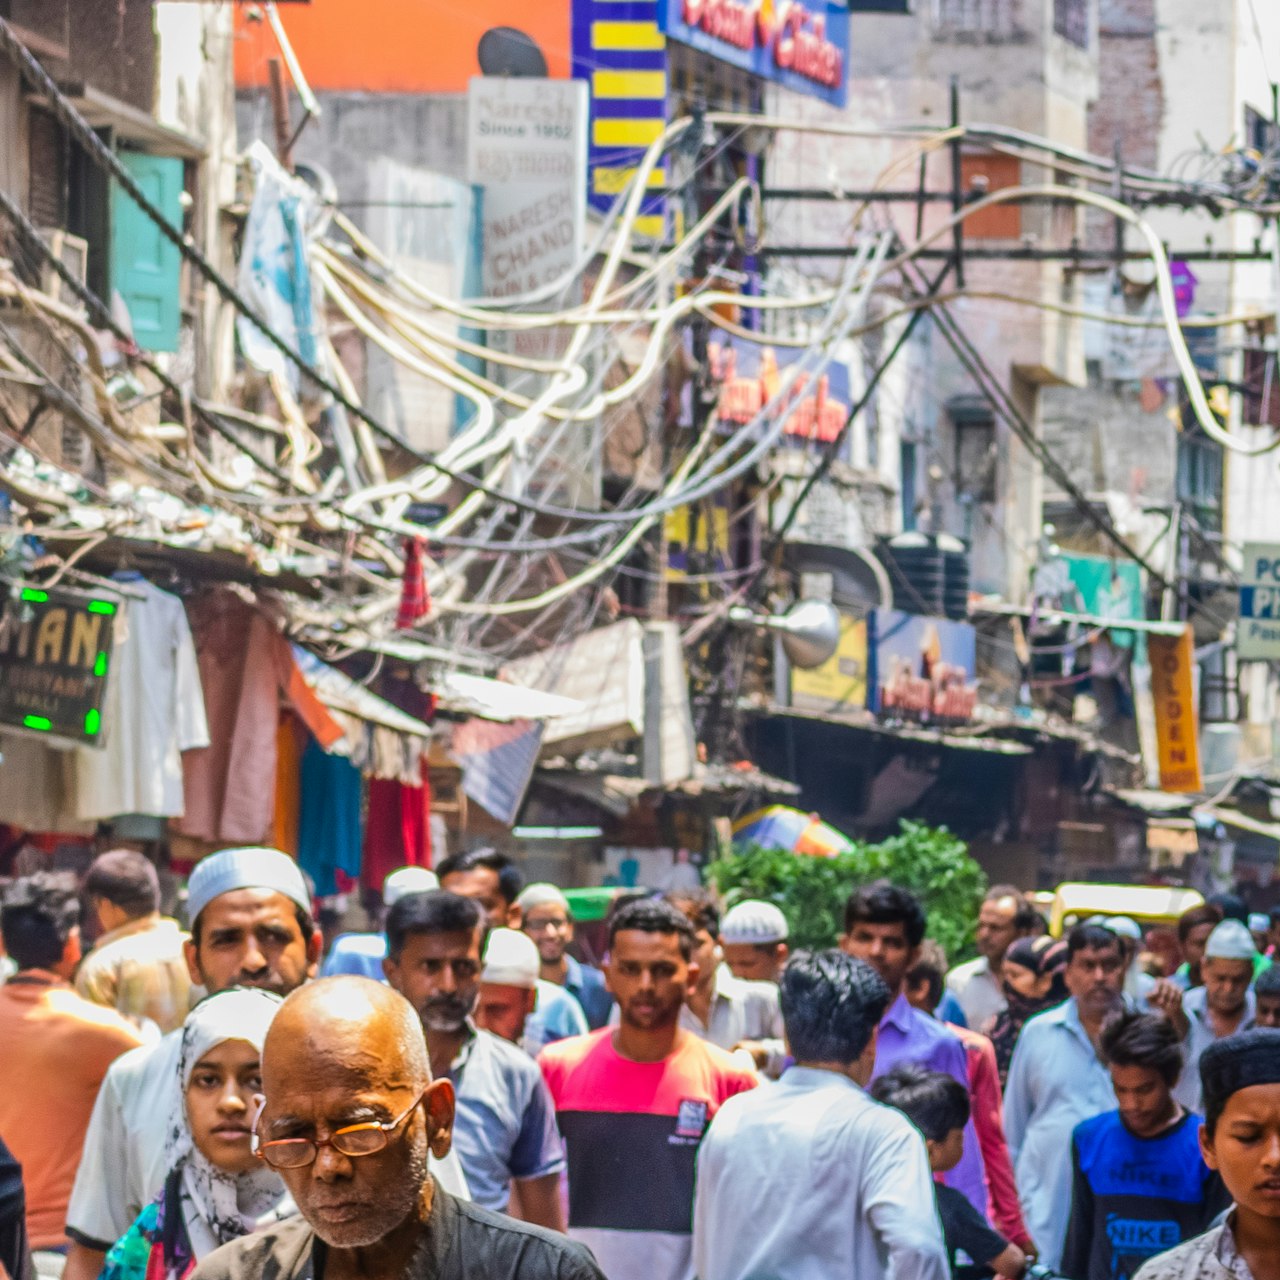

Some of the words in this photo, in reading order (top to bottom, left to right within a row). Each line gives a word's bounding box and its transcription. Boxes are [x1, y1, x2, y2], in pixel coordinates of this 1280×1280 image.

[490, 219, 575, 280] CHAND
[1109, 1168, 1184, 1188] NIKE
[1111, 1223, 1177, 1245] NIKE
